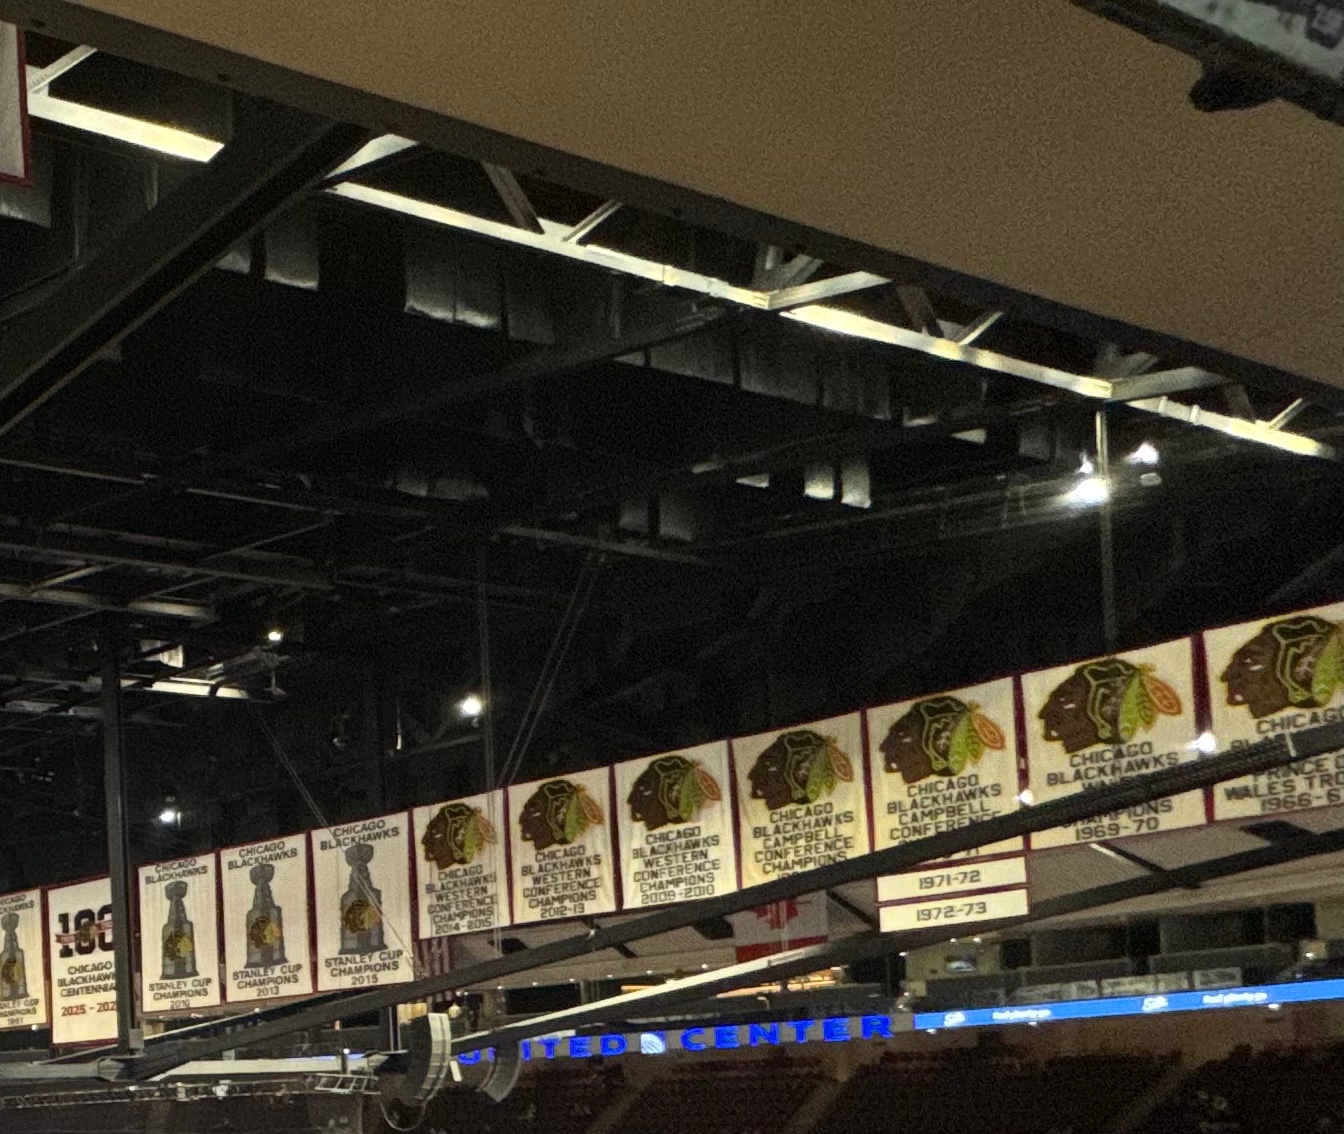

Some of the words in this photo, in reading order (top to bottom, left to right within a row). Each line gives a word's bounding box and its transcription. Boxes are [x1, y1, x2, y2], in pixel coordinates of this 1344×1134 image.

[1069, 741, 1154, 768] CHICAGO
[1047, 751, 1179, 786] BLACKHAWKS
[907, 773, 979, 797] CHICAGO
[887, 783, 1002, 814] BLACKHAWKS
[1261, 788, 1341, 812] 1966-6
[770, 802, 834, 824] CHICAGO
[898, 800, 990, 826] CAMPBELL
[333, 819, 386, 838] CHICAGO
[753, 811, 854, 839] BLACKHAWKS
[1076, 816, 1160, 841] 1969-70
[320, 827, 400, 850] BLACKHAWKS
[645, 826, 701, 845] CHICAGO
[763, 827, 843, 849] CAMPBELL
[238, 841, 286, 858] CHICAGO
[535, 845, 586, 862] CHICAGO
[632, 835, 720, 859] BLACKHAWKS
[755, 836, 854, 863] CONFERENCE
[155, 859, 197, 874] CHICAGO
[227, 848, 298, 870] BLACKHAWKS
[521, 854, 602, 877] BLACKHAWKS
[643, 849, 708, 868] WESTERN
[762, 851, 847, 874] CHAMPIONS
[145, 866, 208, 885] BLACKHAWKS
[438, 864, 483, 881] CHICAGO
[532, 867, 591, 886] WESTERN
[633, 859, 720, 883] CONFERENCE
[919, 870, 981, 890] 1971-72
[425, 872, 497, 894] BLACKHAWKS
[523, 877, 603, 898] CONFERENCE
[640, 872, 715, 893] CHAMPIONS
[428, 893, 497, 915] CONFERENCE
[435, 886, 488, 903] WESTERN
[529, 890, 597, 909] CHAMPIONS
[641, 885, 715, 905] 2009-2010
[433, 906, 494, 925] CHAMPIONS
[540, 902, 585, 919] 2012-13
[916, 901, 987, 922] 1972-73
[58, 904, 113, 959] 100
[435, 917, 492, 935] 2014-2015
[67, 961, 113, 976] CHICAGO
[324, 953, 374, 968] STANLEY
[378, 949, 404, 962] CUP
[232, 967, 276, 981] STANLEY
[280, 963, 303, 975] CUP
[330, 960, 400, 978] CHAMPIONS
[60, 981, 117, 998] CENTENNIA
[148, 981, 187, 992] STANLEY
[191, 978, 212, 989] CUP
[237, 974, 299, 990] CHAMPIONS
[351, 974, 378, 986] 2015
[152, 988, 209, 1001] CHAMPIONS
[256, 986, 280, 997] 2013
[61, 1004, 86, 1017] 2025
[457, 1034, 627, 1066] UITED
[679, 1013, 894, 1052] CENTER
